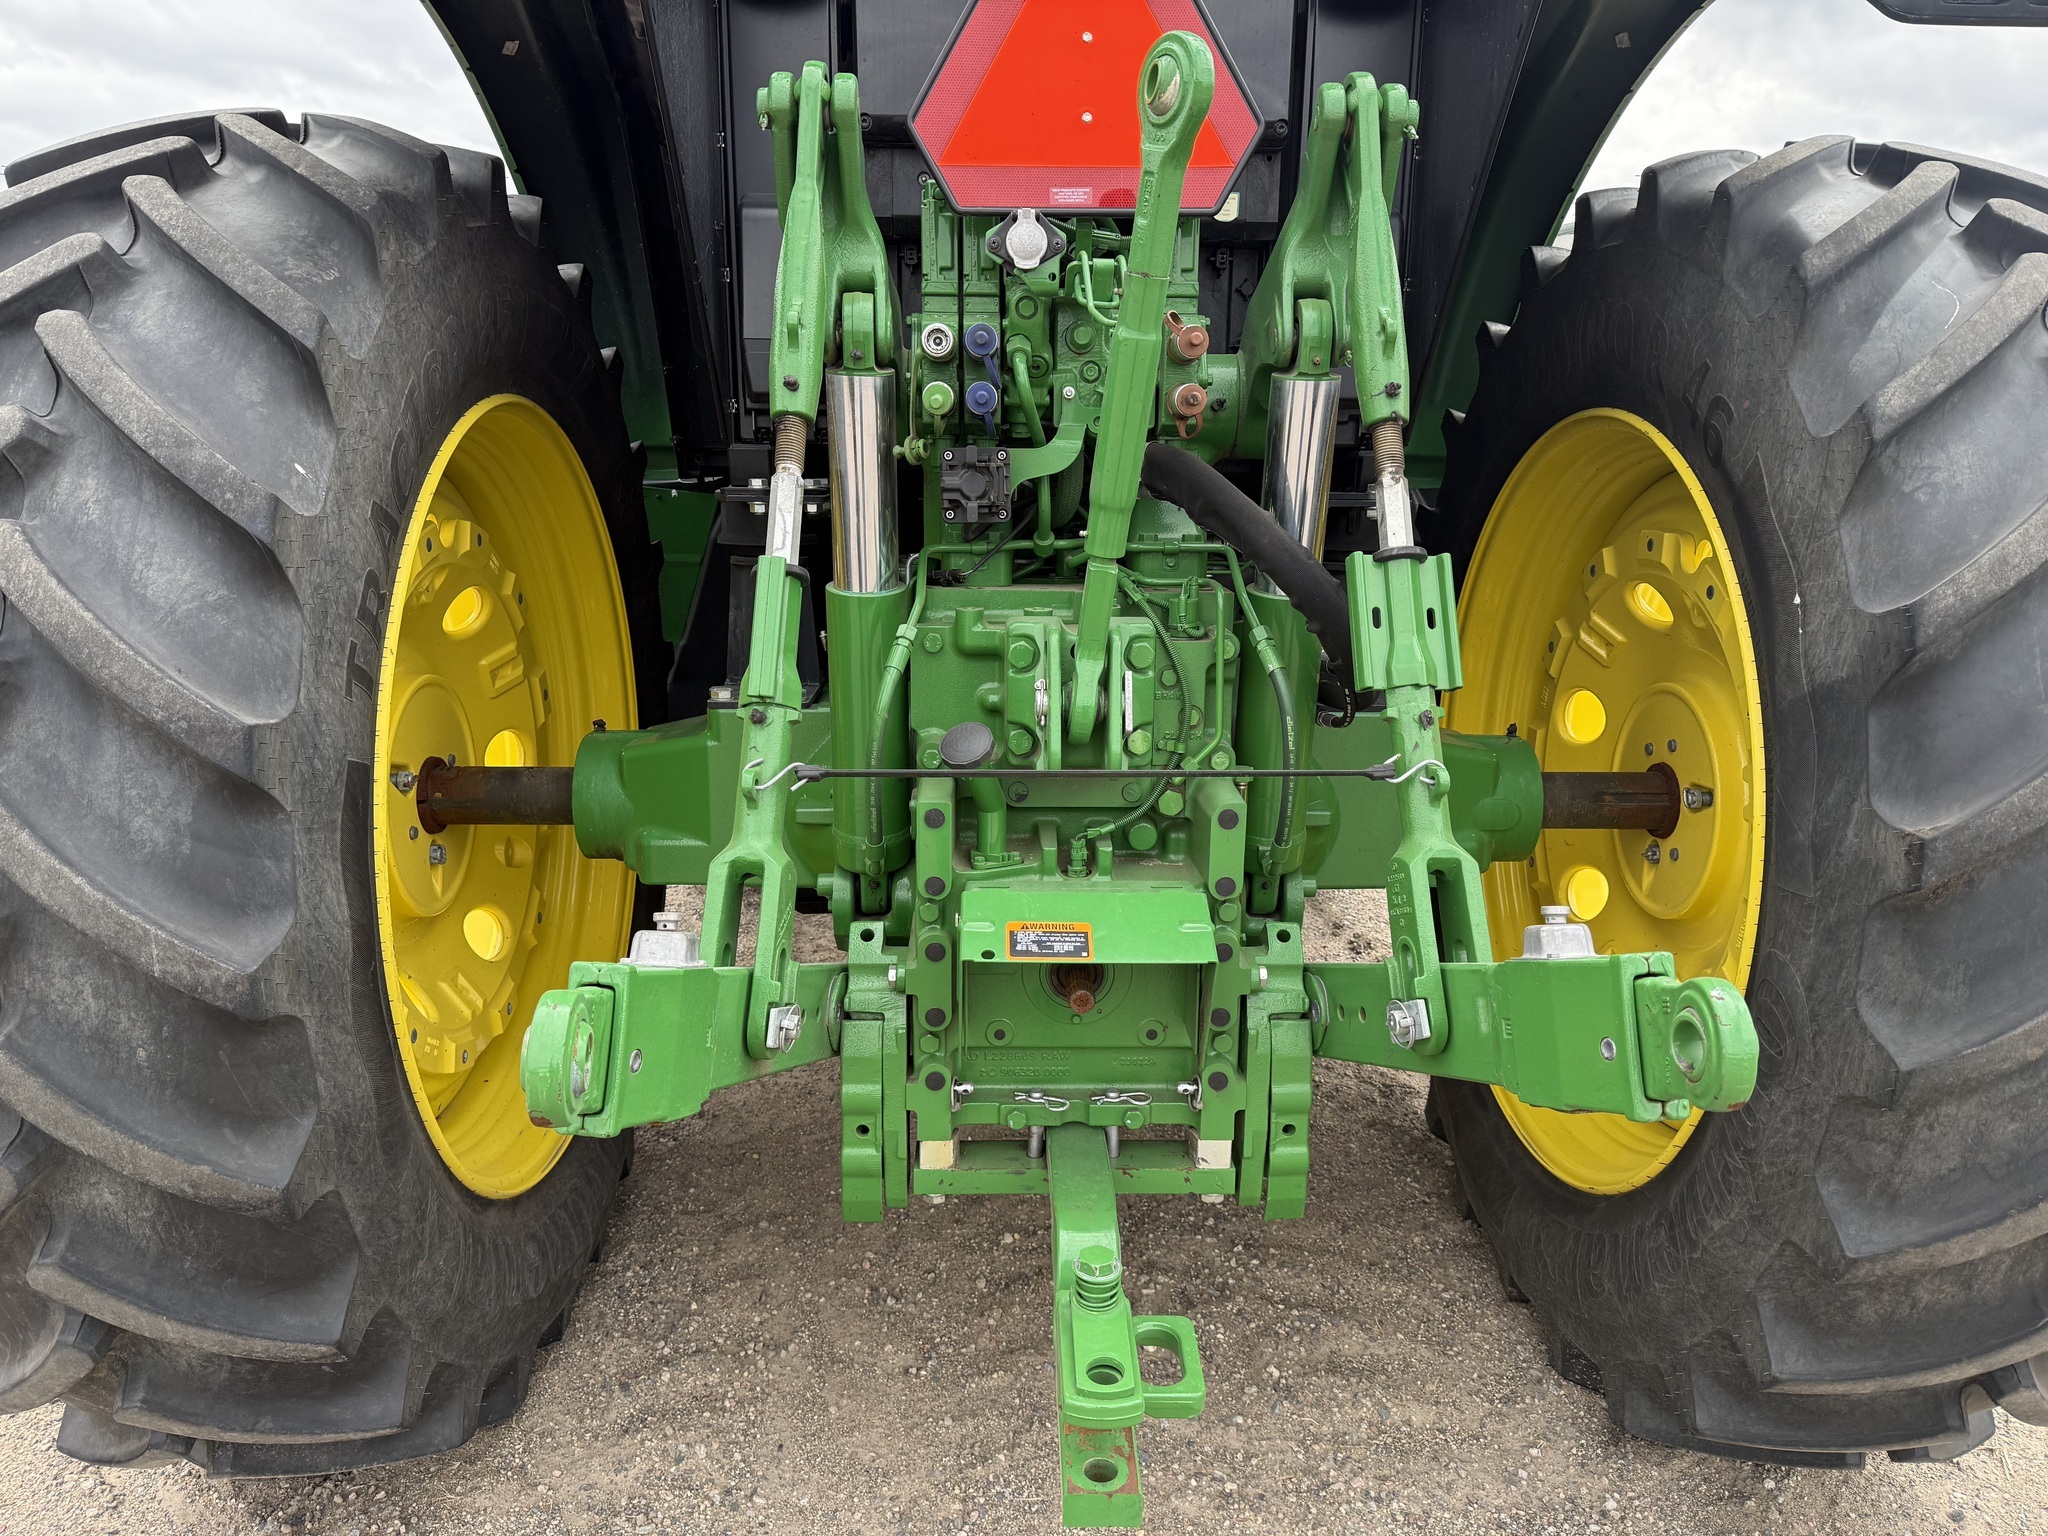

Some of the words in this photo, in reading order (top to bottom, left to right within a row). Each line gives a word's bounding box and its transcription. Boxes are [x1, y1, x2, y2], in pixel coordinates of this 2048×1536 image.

[1681, 358, 1737, 471] 46
[1155, 691, 1182, 701] BRAK
[1164, 731, 1202, 741] CLCH
[1029, 923, 1075, 931] WARNING
